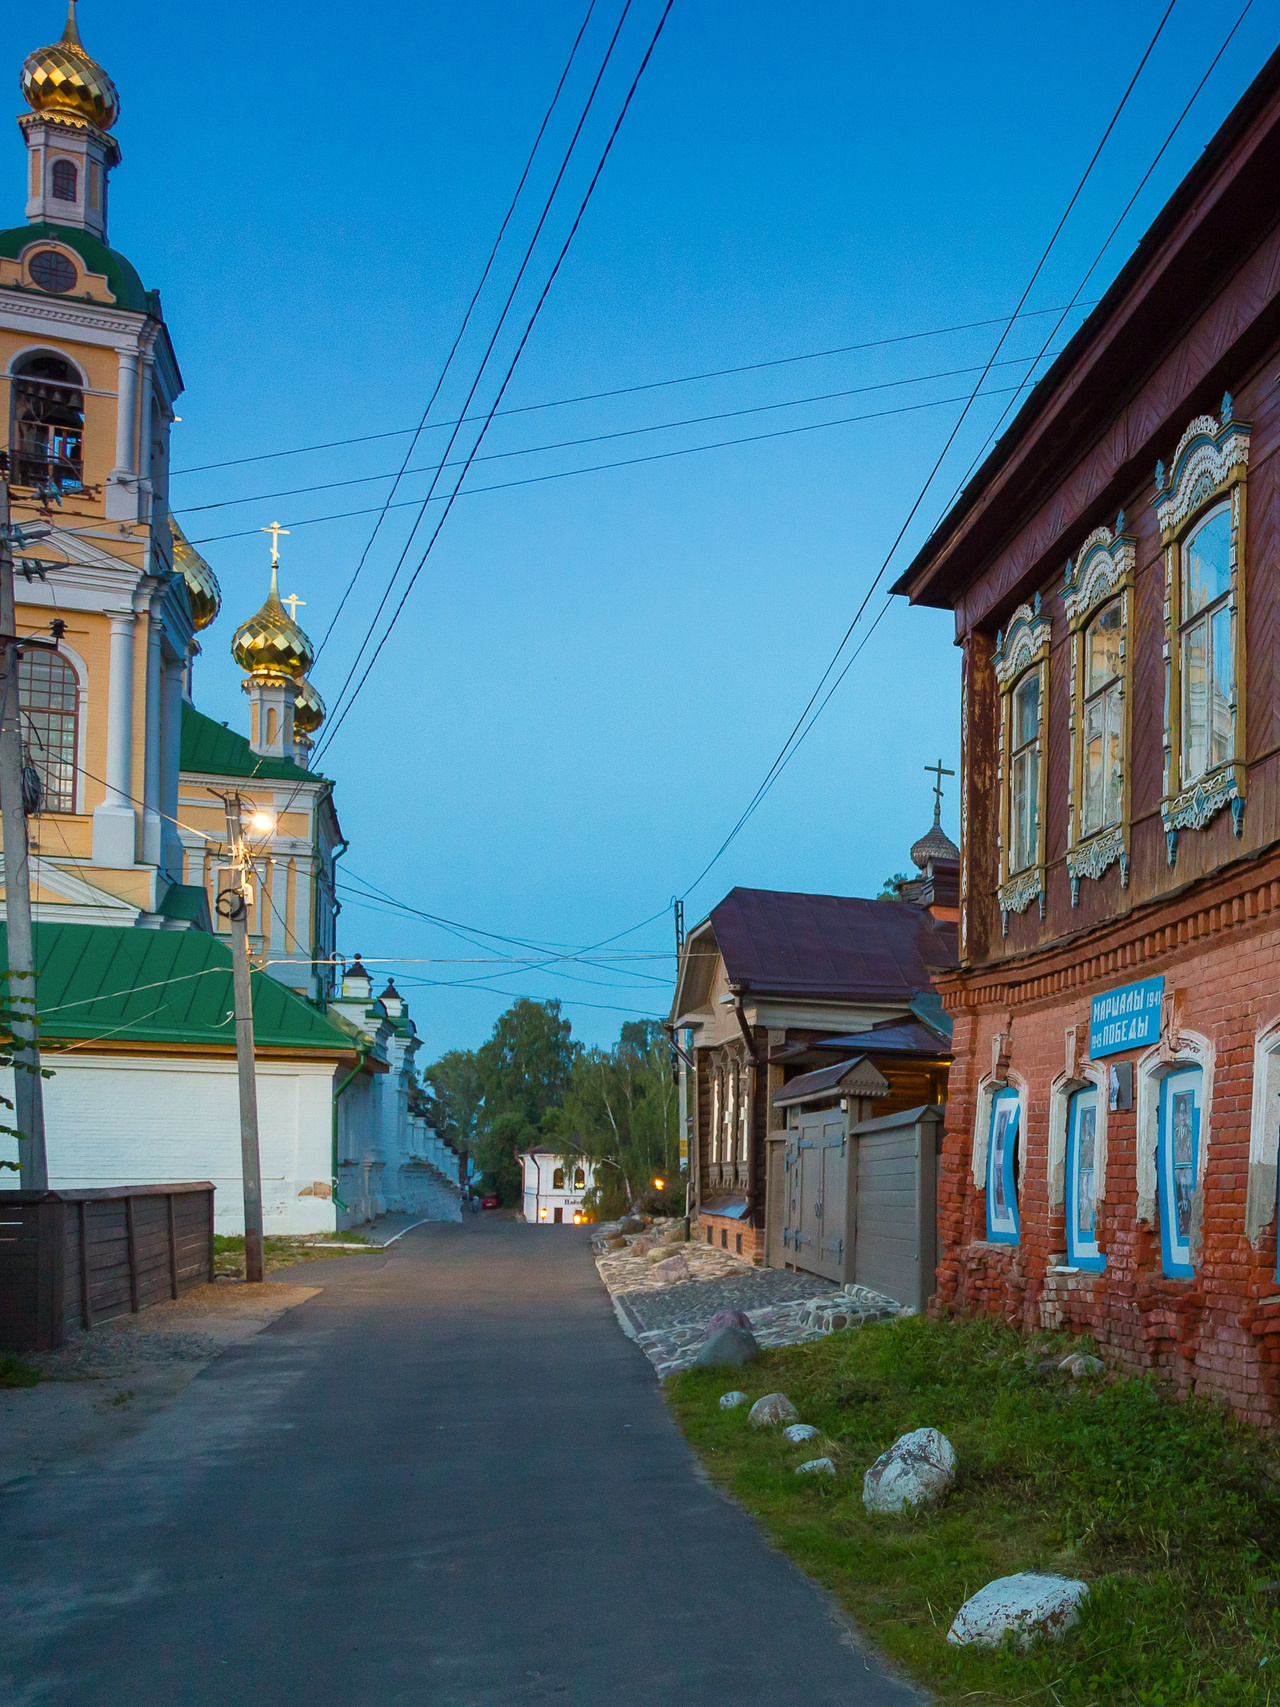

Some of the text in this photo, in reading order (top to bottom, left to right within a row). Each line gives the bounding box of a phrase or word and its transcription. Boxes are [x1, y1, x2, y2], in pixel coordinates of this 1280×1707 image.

[1093, 988, 1162, 1023] МАРШАЛЫ 1941
[1103, 1015, 1149, 1047] ПОБЕДЫ
